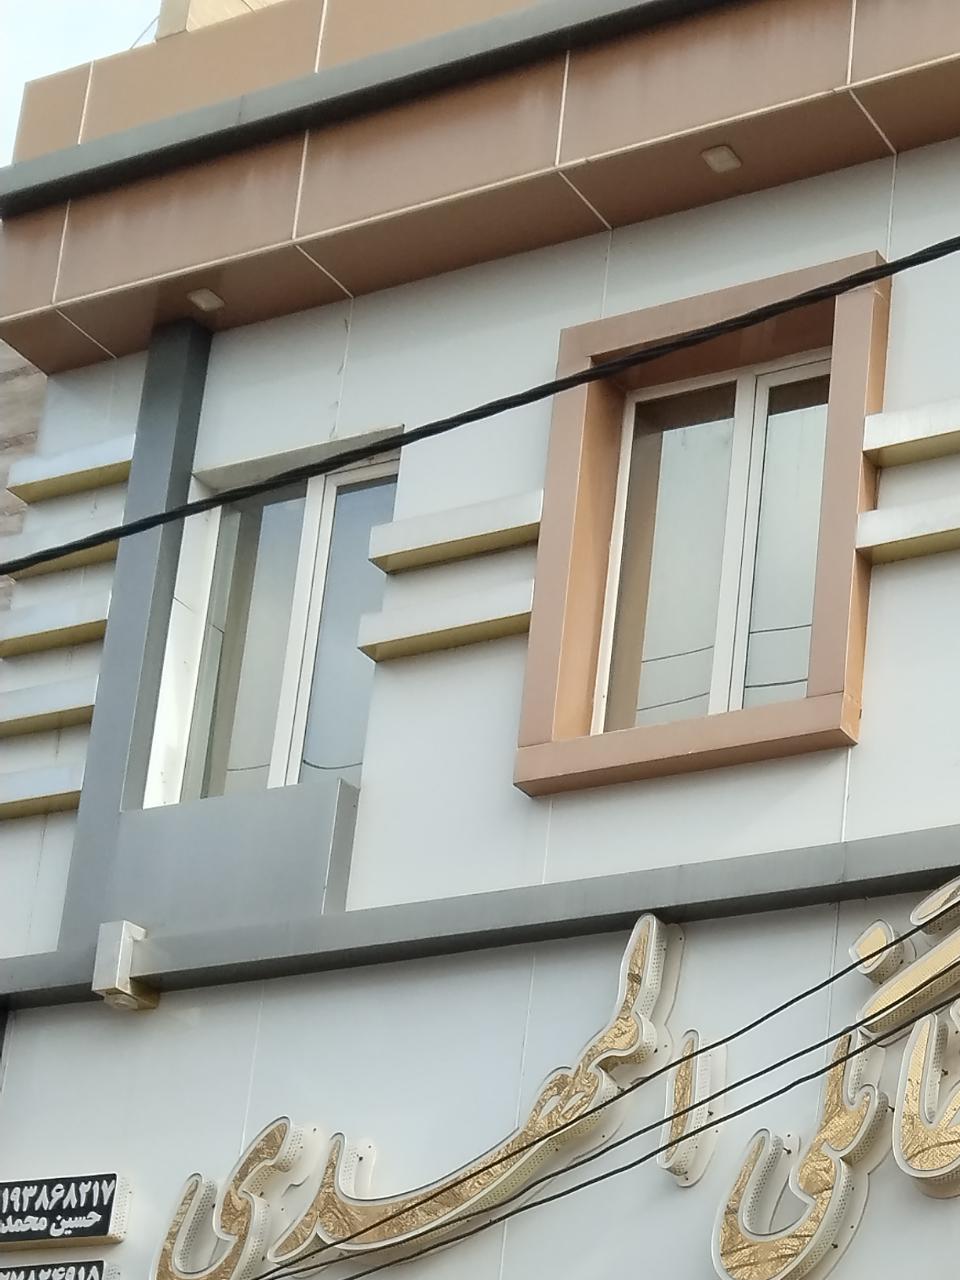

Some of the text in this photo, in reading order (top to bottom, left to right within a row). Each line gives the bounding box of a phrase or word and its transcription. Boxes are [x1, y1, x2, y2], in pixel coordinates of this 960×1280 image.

[0, 1179, 116, 1213] ۱۹۳۸۶۸۲۱۷
[0, 1211, 102, 1237] حسین محمد
